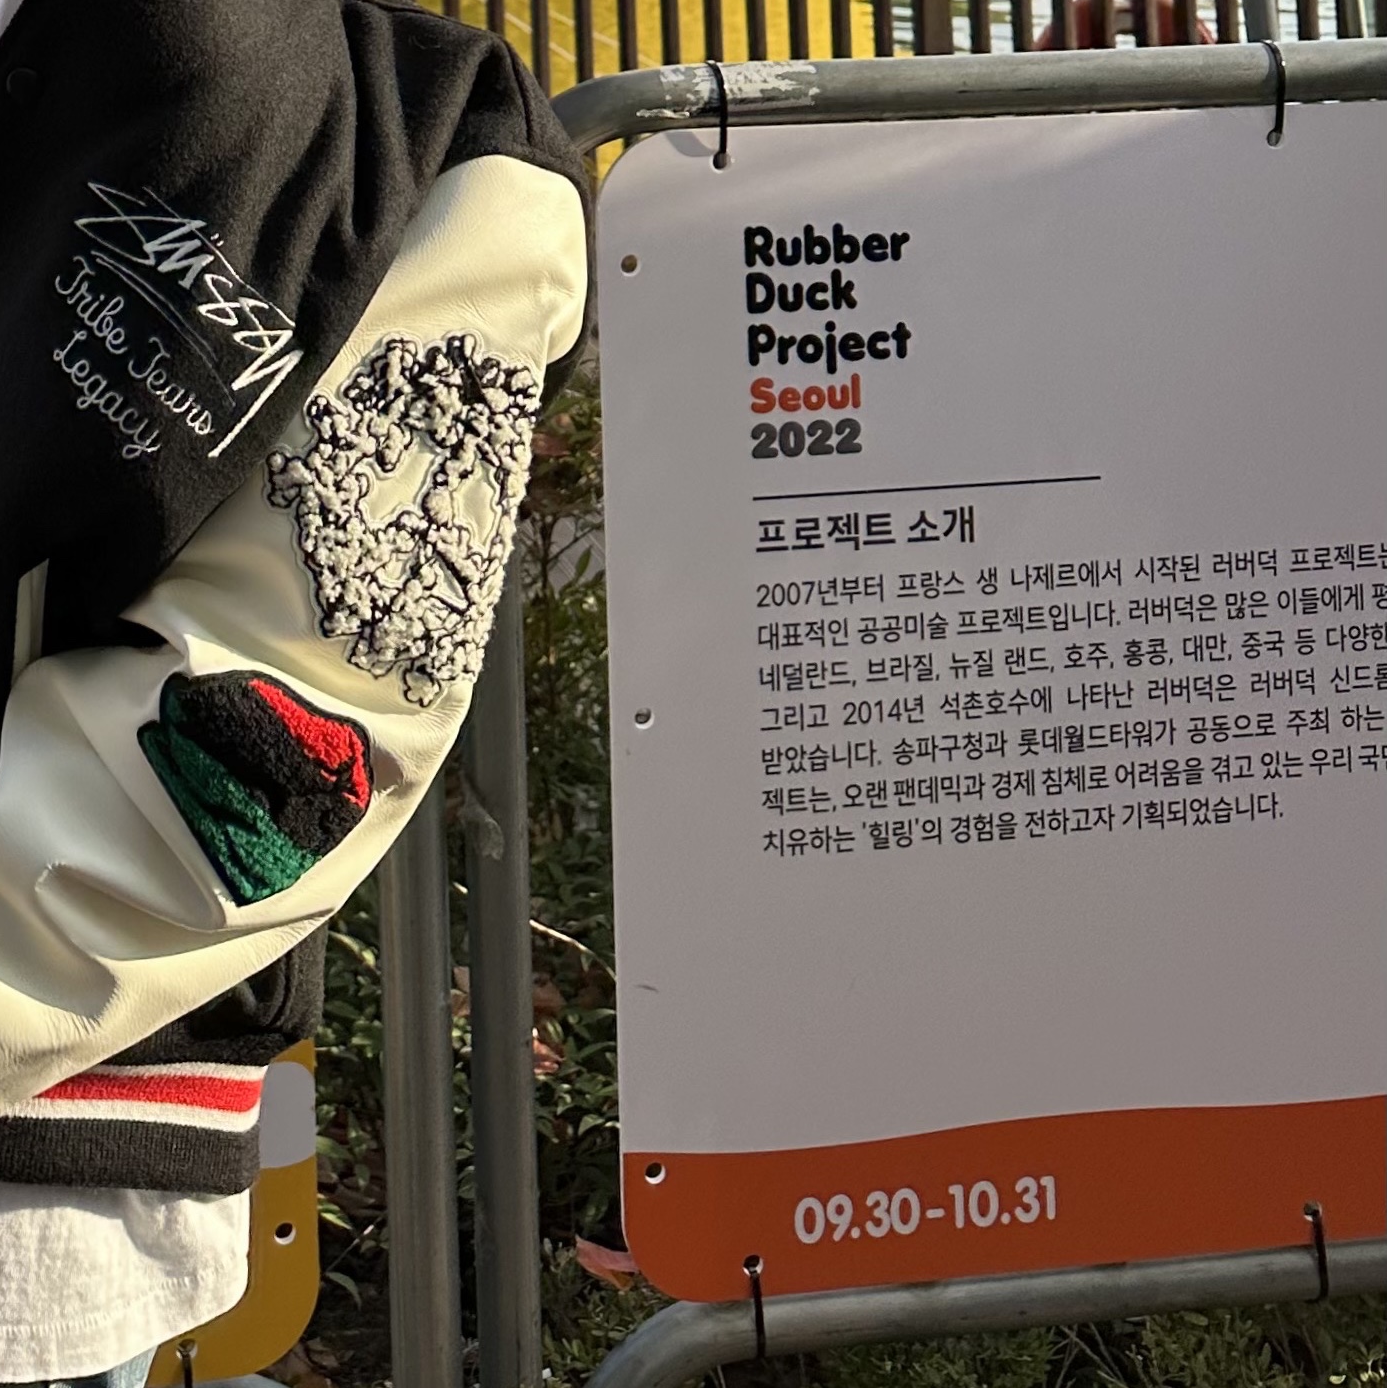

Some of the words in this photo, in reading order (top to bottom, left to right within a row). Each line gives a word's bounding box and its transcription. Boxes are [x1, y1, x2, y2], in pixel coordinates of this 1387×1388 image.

[744, 222, 910, 267] Rubber
[746, 269, 857, 314] Duck
[55, 256, 127, 354] Tribe
[128, 336, 214, 435] Tears
[748, 320, 911, 374] Project
[53, 331, 161, 459] Legacy
[750, 373, 861, 414] Seoul
[751, 418, 862, 459] 2022
[756, 513, 896, 552] 프로젝트
[907, 506, 975, 544] 소개
[757, 574, 884, 607] 2007년부터
[897, 570, 965, 600] 프랑스
[977, 567, 998, 595] 생
[1011, 559, 1122, 592] 나제르에서
[1135, 554, 1201, 584] 시작된
[1213, 549, 1277, 579] 러버덕
[758, 617, 848, 650] 대표적인
[858, 612, 948, 644] 공공미술
[957, 599, 1121, 635] 프로젝트입니다.
[1129, 594, 1217, 624] 러버덕은
[1225, 591, 1269, 620] 많은
[1278, 584, 1364, 616] 이들에게
[759, 661, 856, 692] 네덜란드,
[866, 653, 939, 682] 브라질,
[949, 649, 994, 679] 뉴질
[1005, 646, 1055, 675] 랜드,
[1064, 643, 1113, 669] 호주,
[1123, 638, 1173, 667] 홍콩,
[1183, 633, 1231, 662] 대만,
[1242, 630, 1284, 659] 중국
[1295, 628, 1316, 655] 등
[760, 703, 829, 732] 그리고
[843, 695, 924, 725] 2014년
[940, 686, 1052, 720] 석촌호수에
[1068, 680, 1134, 710] 나타난
[1148, 674, 1236, 704] 러버덕은
[1251, 668, 1315, 697] 러버덕
[762, 739, 881, 775] 받았습니다.
[893, 730, 1007, 765] 송파구청과
[1017, 718, 1176, 757] 롯데월드타워가
[1187, 713, 1276, 744] 공동으로
[1287, 708, 1329, 736] 주최
[1341, 705, 1385, 732] 하는
[762, 787, 836, 816] 젝트는,
[842, 780, 887, 809] 오랜
[893, 773, 985, 806] 팬데믹과
[992, 770, 1035, 799] 경제
[1042, 766, 1110, 796] 침체로
[1115, 758, 1204, 790] 어려움을
[1212, 755, 1254, 783] 겪고
[1262, 751, 1303, 780] 있는
[1309, 746, 1352, 776] 우리
[763, 825, 856, 857] 치유하는
[862, 817, 942, 850] '힐링'의
[950, 813, 1018, 844] 경험을
[1024, 803, 1115, 838] 전하고자
[1123, 792, 1283, 830] 기획되었습니다.
[794, 1175, 1058, 1244] 09.30-10.31
